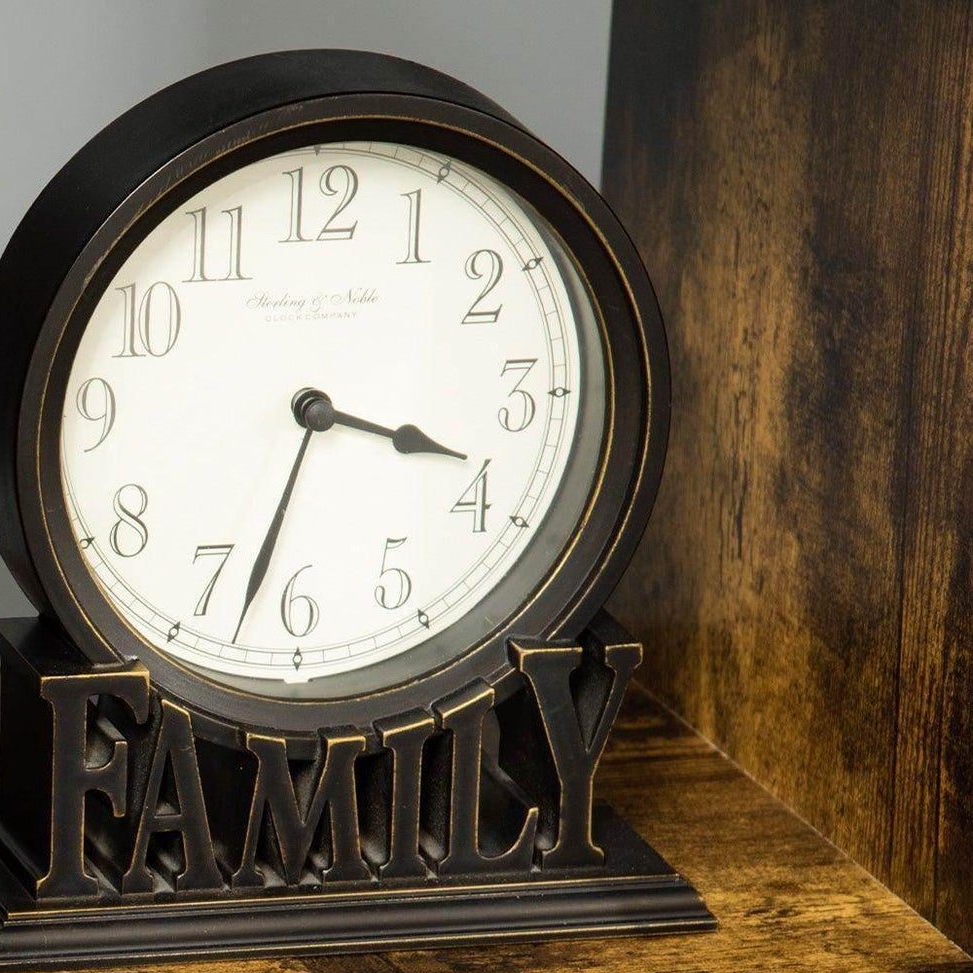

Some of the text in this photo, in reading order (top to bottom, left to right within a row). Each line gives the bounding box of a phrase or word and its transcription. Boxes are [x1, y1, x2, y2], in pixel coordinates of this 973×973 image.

[277, 164, 361, 245] 12
[396, 188, 432, 266] 1
[182, 204, 253, 283] 11
[111, 280, 182, 359] 10
[246, 291, 306, 310] Sterling
[330, 286, 379, 305] Noble
[460, 248, 504, 325] 2
[75, 377, 116, 453] 9
[497, 358, 538, 433] 3
[108, 483, 149, 558] 8
[449, 457, 493, 533] 4
[192, 543, 235, 617] 7
[279, 564, 320, 638] 6
[374, 537, 413, 610] 5
[35, 638, 644, 899] FAMILY
